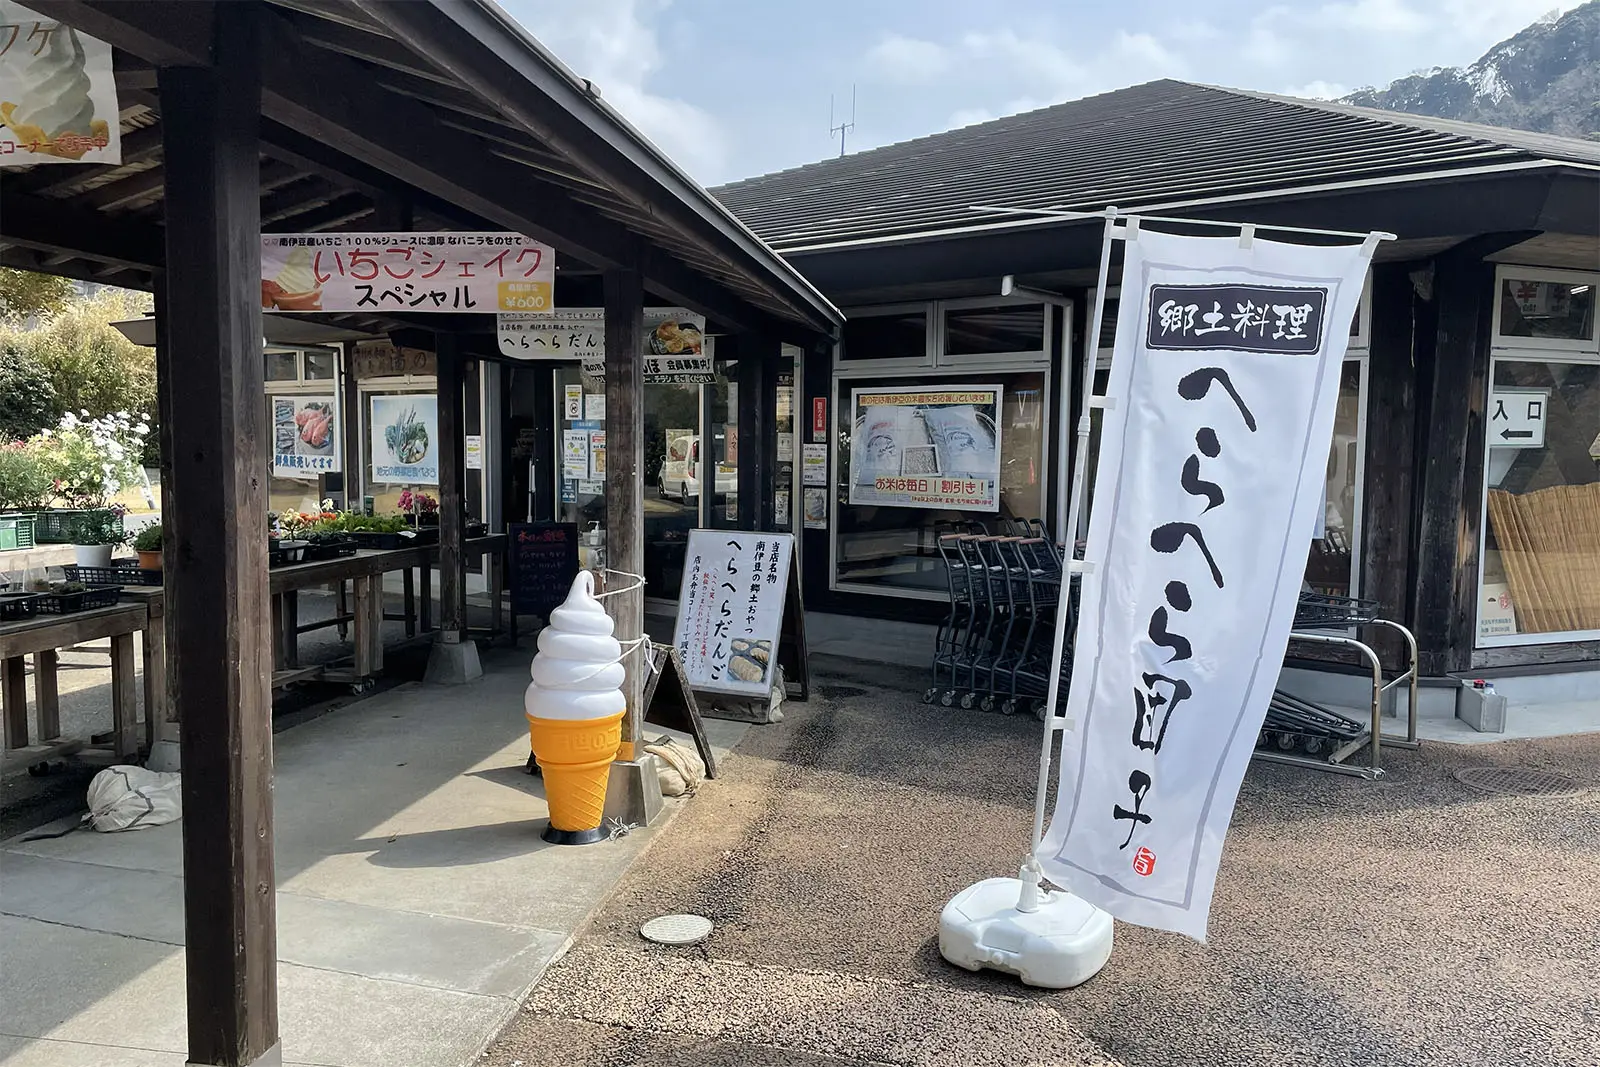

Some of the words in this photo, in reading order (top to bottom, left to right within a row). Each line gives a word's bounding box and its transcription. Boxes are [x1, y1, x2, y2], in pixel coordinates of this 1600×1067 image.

[0, 136, 108, 153] コーナーで販売中
[314, 248, 542, 283] いちごシェイク
[354, 284, 477, 309] スペシャル
[505, 295, 544, 309] ¥600
[1158, 300, 1313, 341] 郷土料理
[502, 333, 605, 349] へらへらだん
[1492, 400, 1542, 421] 入口
[275, 455, 333, 469] 鮮魚販売してます
[766, 541, 781, 584] 当店名物
[744, 540, 766, 634] 南伊豆の郷土おやつ
[710, 540, 742, 681] へらへらだんご
[1114, 367, 1257, 850] へらへら団子
